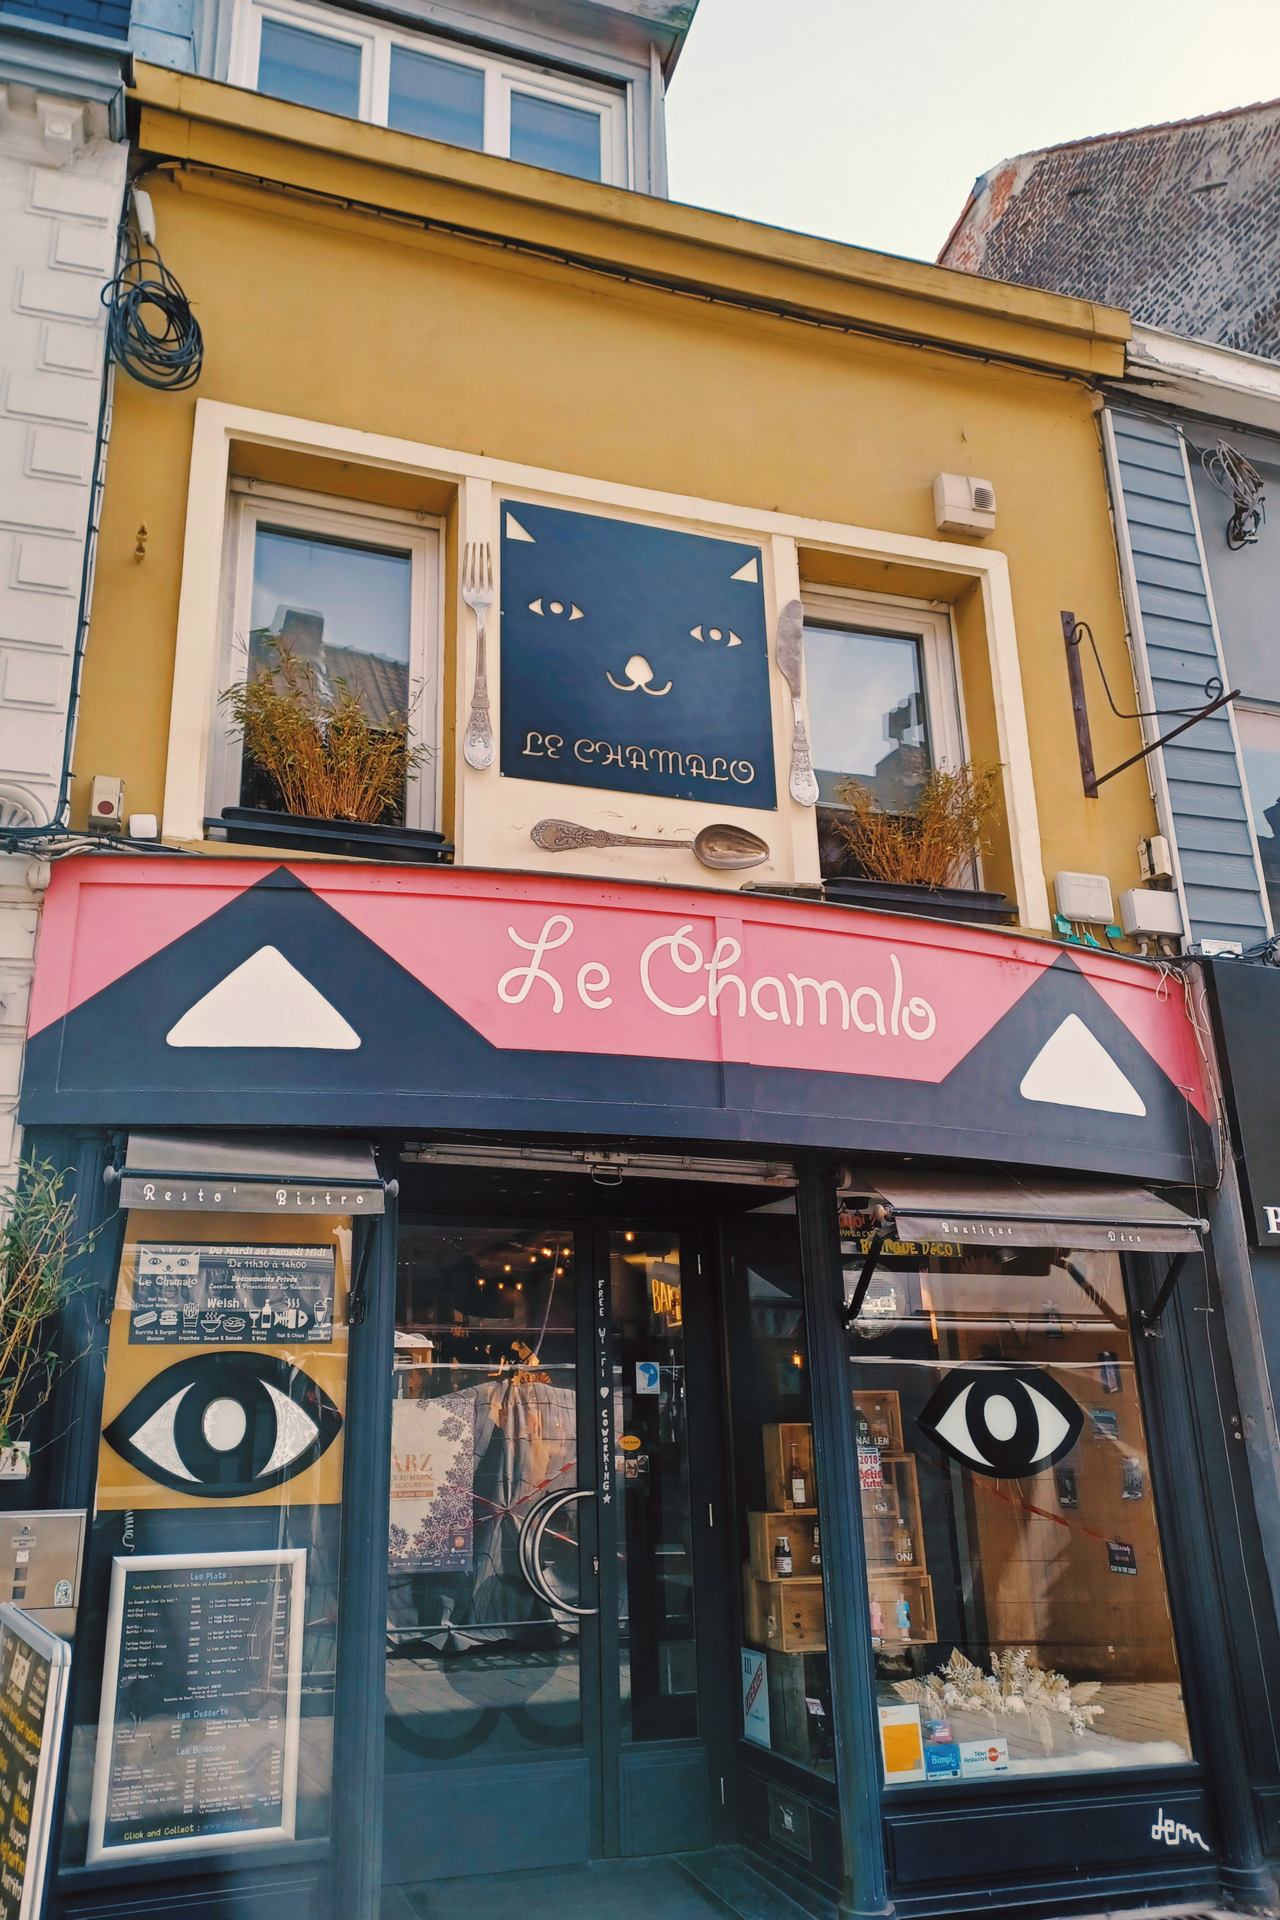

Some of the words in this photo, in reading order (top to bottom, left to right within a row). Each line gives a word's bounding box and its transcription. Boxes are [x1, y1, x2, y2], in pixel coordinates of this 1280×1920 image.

[522, 732, 565, 760] LE
[573, 738, 755, 784] CHAMALO
[497, 914, 612, 1014] Le
[640, 924, 936, 1040] Chamalo
[275, 1189, 364, 1206] Bistro
[941, 1222, 1013, 1237] Boutique
[1107, 1230, 1142, 1243] Déco
[208, 1246, 223, 1255] Du
[224, 1246, 253, 1255] Mardi
[255, 1248, 267, 1256] au
[268, 1247, 303, 1256] Samedi
[305, 1248, 326, 1257] Midi
[227, 1258, 242, 1268] De
[244, 1259, 269, 1268] 11h30
[272, 1260, 278, 1268] à
[281, 1259, 307, 1269] 14h00
[138, 1276, 152, 1286] Le
[155, 1276, 198, 1288] Chamalo
[207, 1298, 240, 1309] Welsh
[859, 1455, 879, 1465] 2018
[190, 1573, 203, 1581] Les
[177, 1711, 191, 1720] Les
[124, 1828, 146, 1841] Click
[146, 1825, 161, 1837] and
[164, 1823, 195, 1836] Collect
